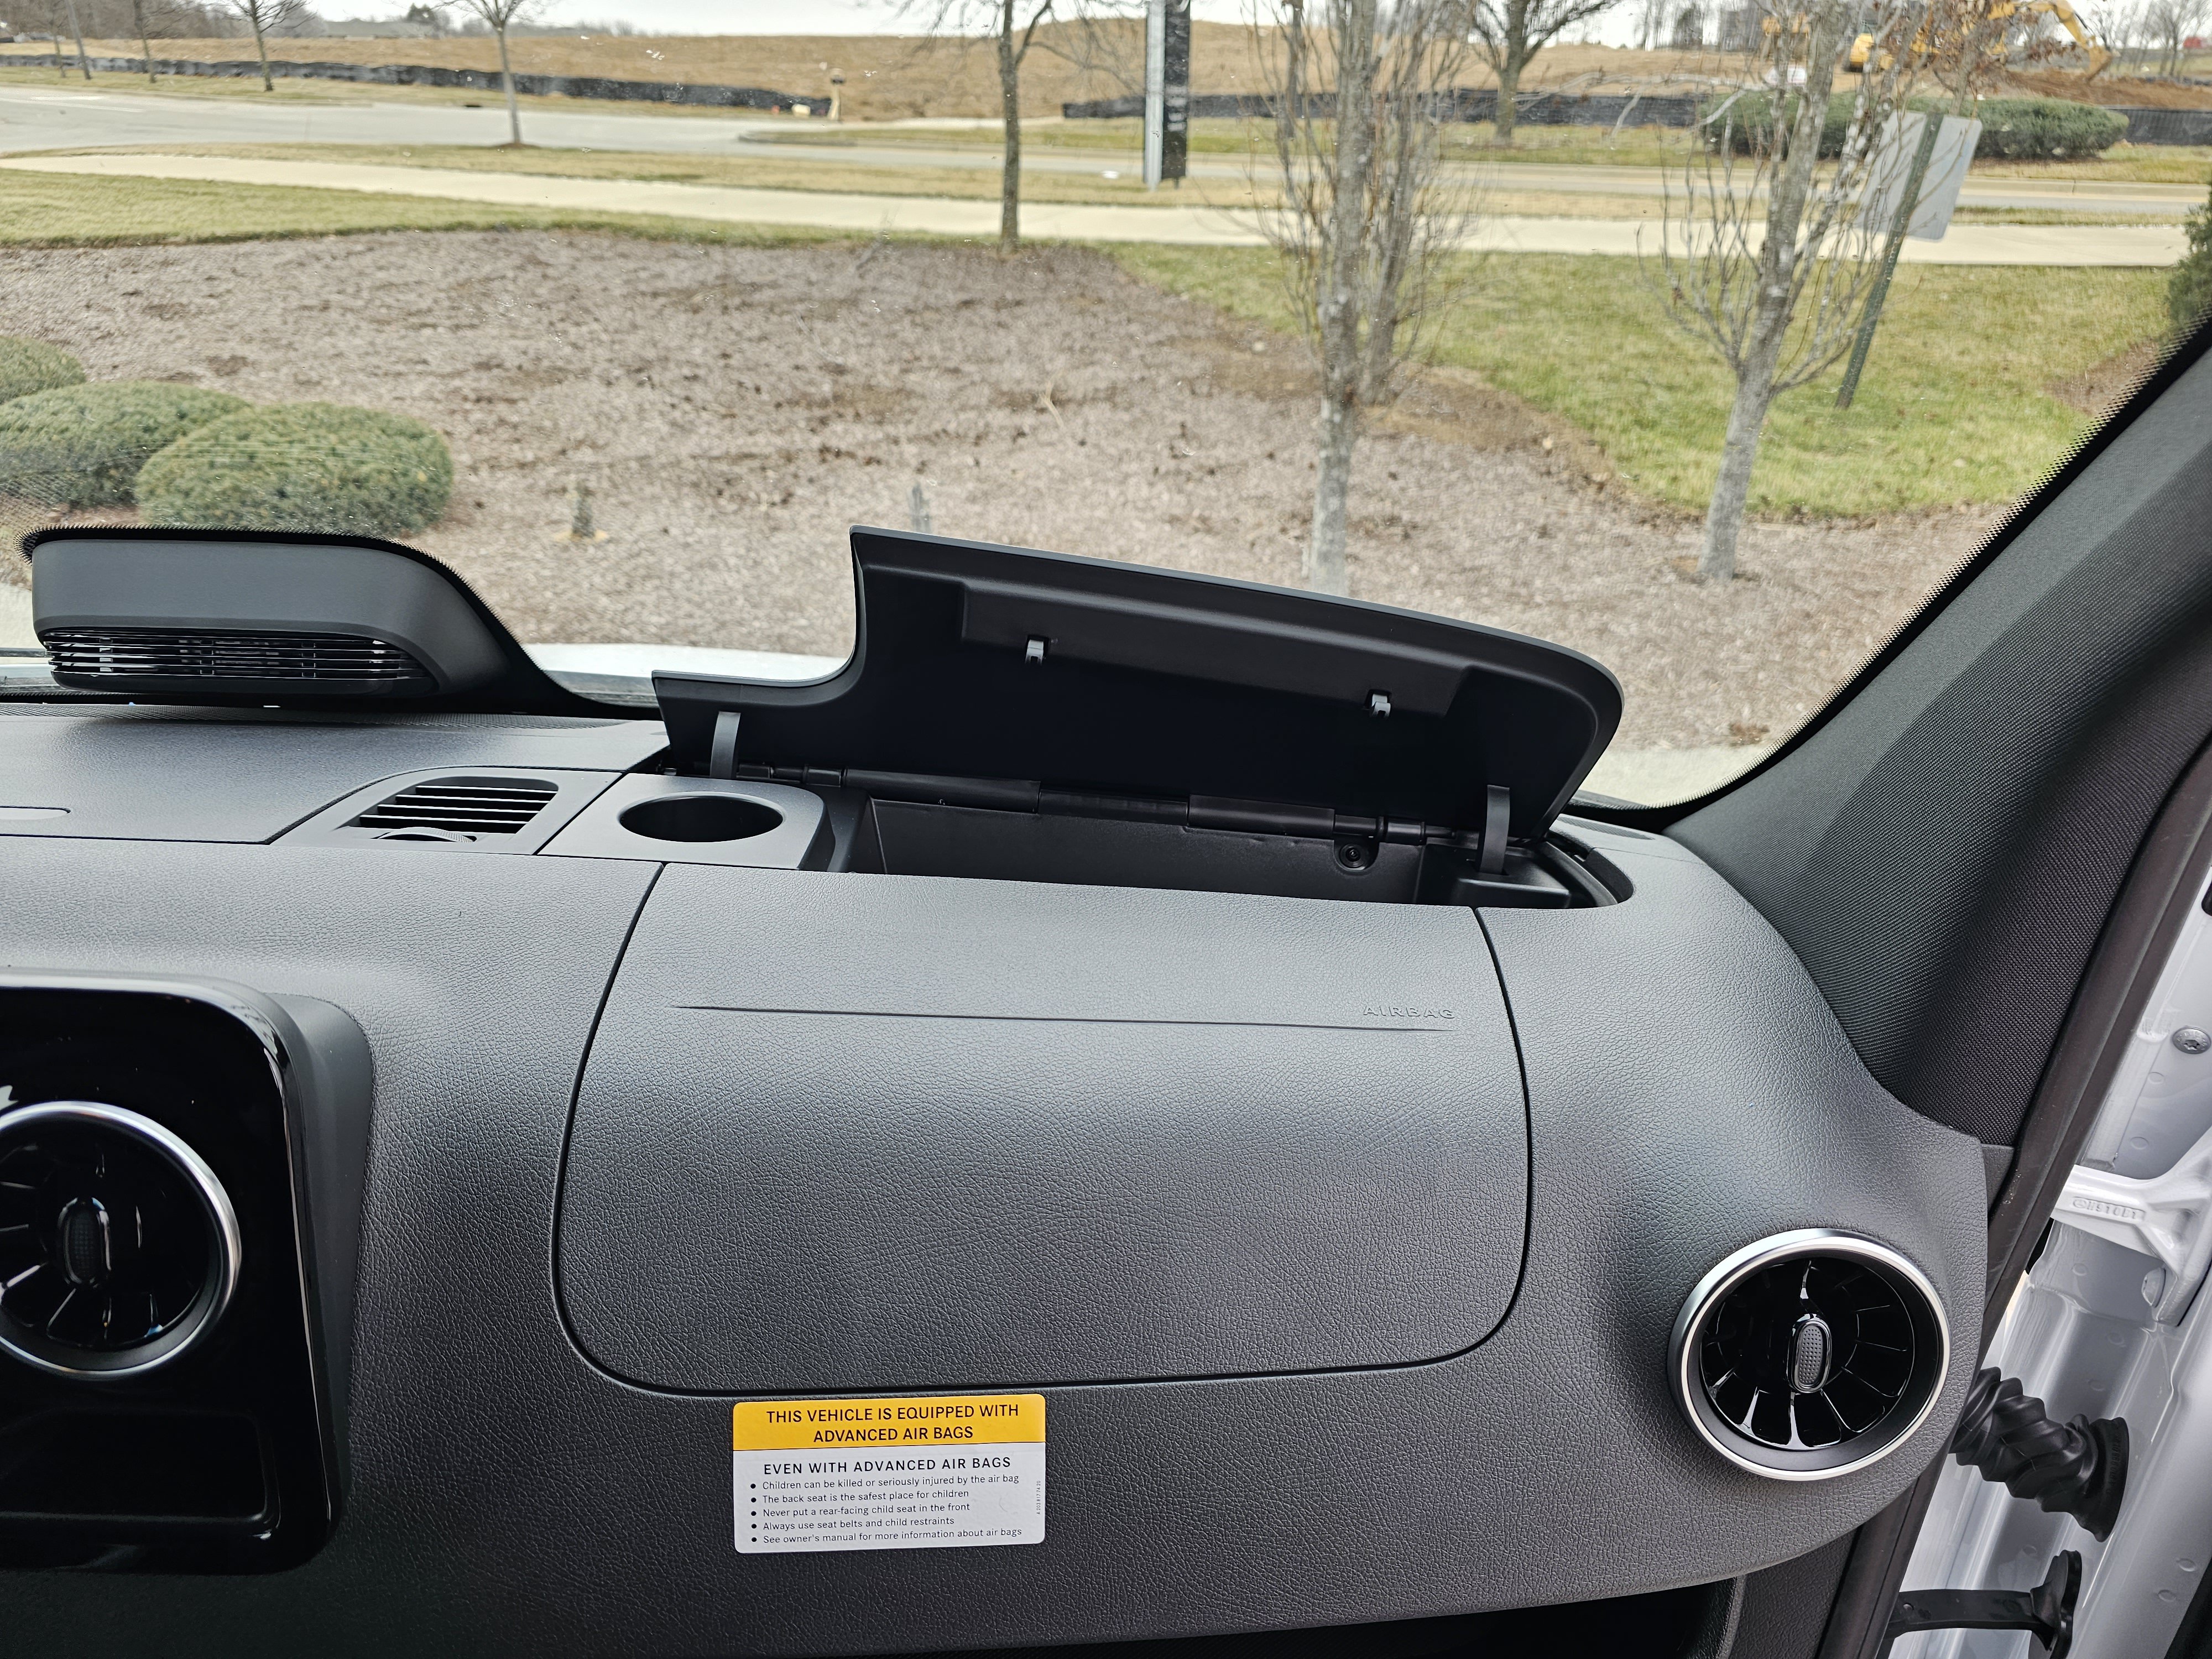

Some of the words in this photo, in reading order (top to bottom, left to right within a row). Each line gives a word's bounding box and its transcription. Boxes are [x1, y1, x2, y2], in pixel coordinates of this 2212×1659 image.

[1363, 1005, 1455, 1019] AIRBAG
[766, 1410, 802, 1423] THIS
[807, 1408, 873, 1422] VEHICLE
[878, 1407, 892, 1420] IS
[898, 1405, 974, 1420] EQUIPPED
[979, 1404, 1018, 1417] WITH
[813, 1428, 898, 1442] ADVANCED
[902, 1427, 928, 1440] AIR
[934, 1426, 973, 1439] BAGS
[764, 1463, 802, 1475] EVEN
[808, 1462, 847, 1473] WITH
[853, 1459, 936, 1472] ADVANCED
[941, 1458, 966, 1469] AIR
[972, 1457, 1010, 1468] BAGS
[763, 1481, 801, 1490] Children
[824, 1480, 835, 1488] be
[838, 1479, 862, 1488] killed
[878, 1477, 920, 1487] seriously
[922, 1476, 954, 1486] injured
[957, 1475, 968, 1485] by
[971, 1475, 985, 1483] the
[988, 1474, 1000, 1483] air
[1003, 1474, 1019, 1484] bag
[782, 1494, 804, 1503] back
[830, 1493, 837, 1501] is
[841, 1493, 855, 1501] the
[858, 1492, 886, 1501] safest
[889, 1491, 914, 1501] place
[916, 1490, 929, 1499] for
[932, 1489, 969, 1498] children
[763, 1509, 790, 1517] Never
[793, 1509, 808, 1518] put
[820, 1506, 869, 1516] rear-facing
[872, 1505, 893, 1514] child
[930, 1504, 945, 1512] the
[763, 1522, 795, 1532] Always
[840, 1520, 863, 1528] belts
[865, 1519, 882, 1527] and
[885, 1518, 907, 1526] child
[910, 1517, 954, 1526] restraints
[783, 1534, 820, 1543] owner's
[823, 1533, 856, 1541] manual
[859, 1532, 872, 1541] for
[901, 1530, 954, 1539] information
[1001, 1528, 1022, 1537] bags
